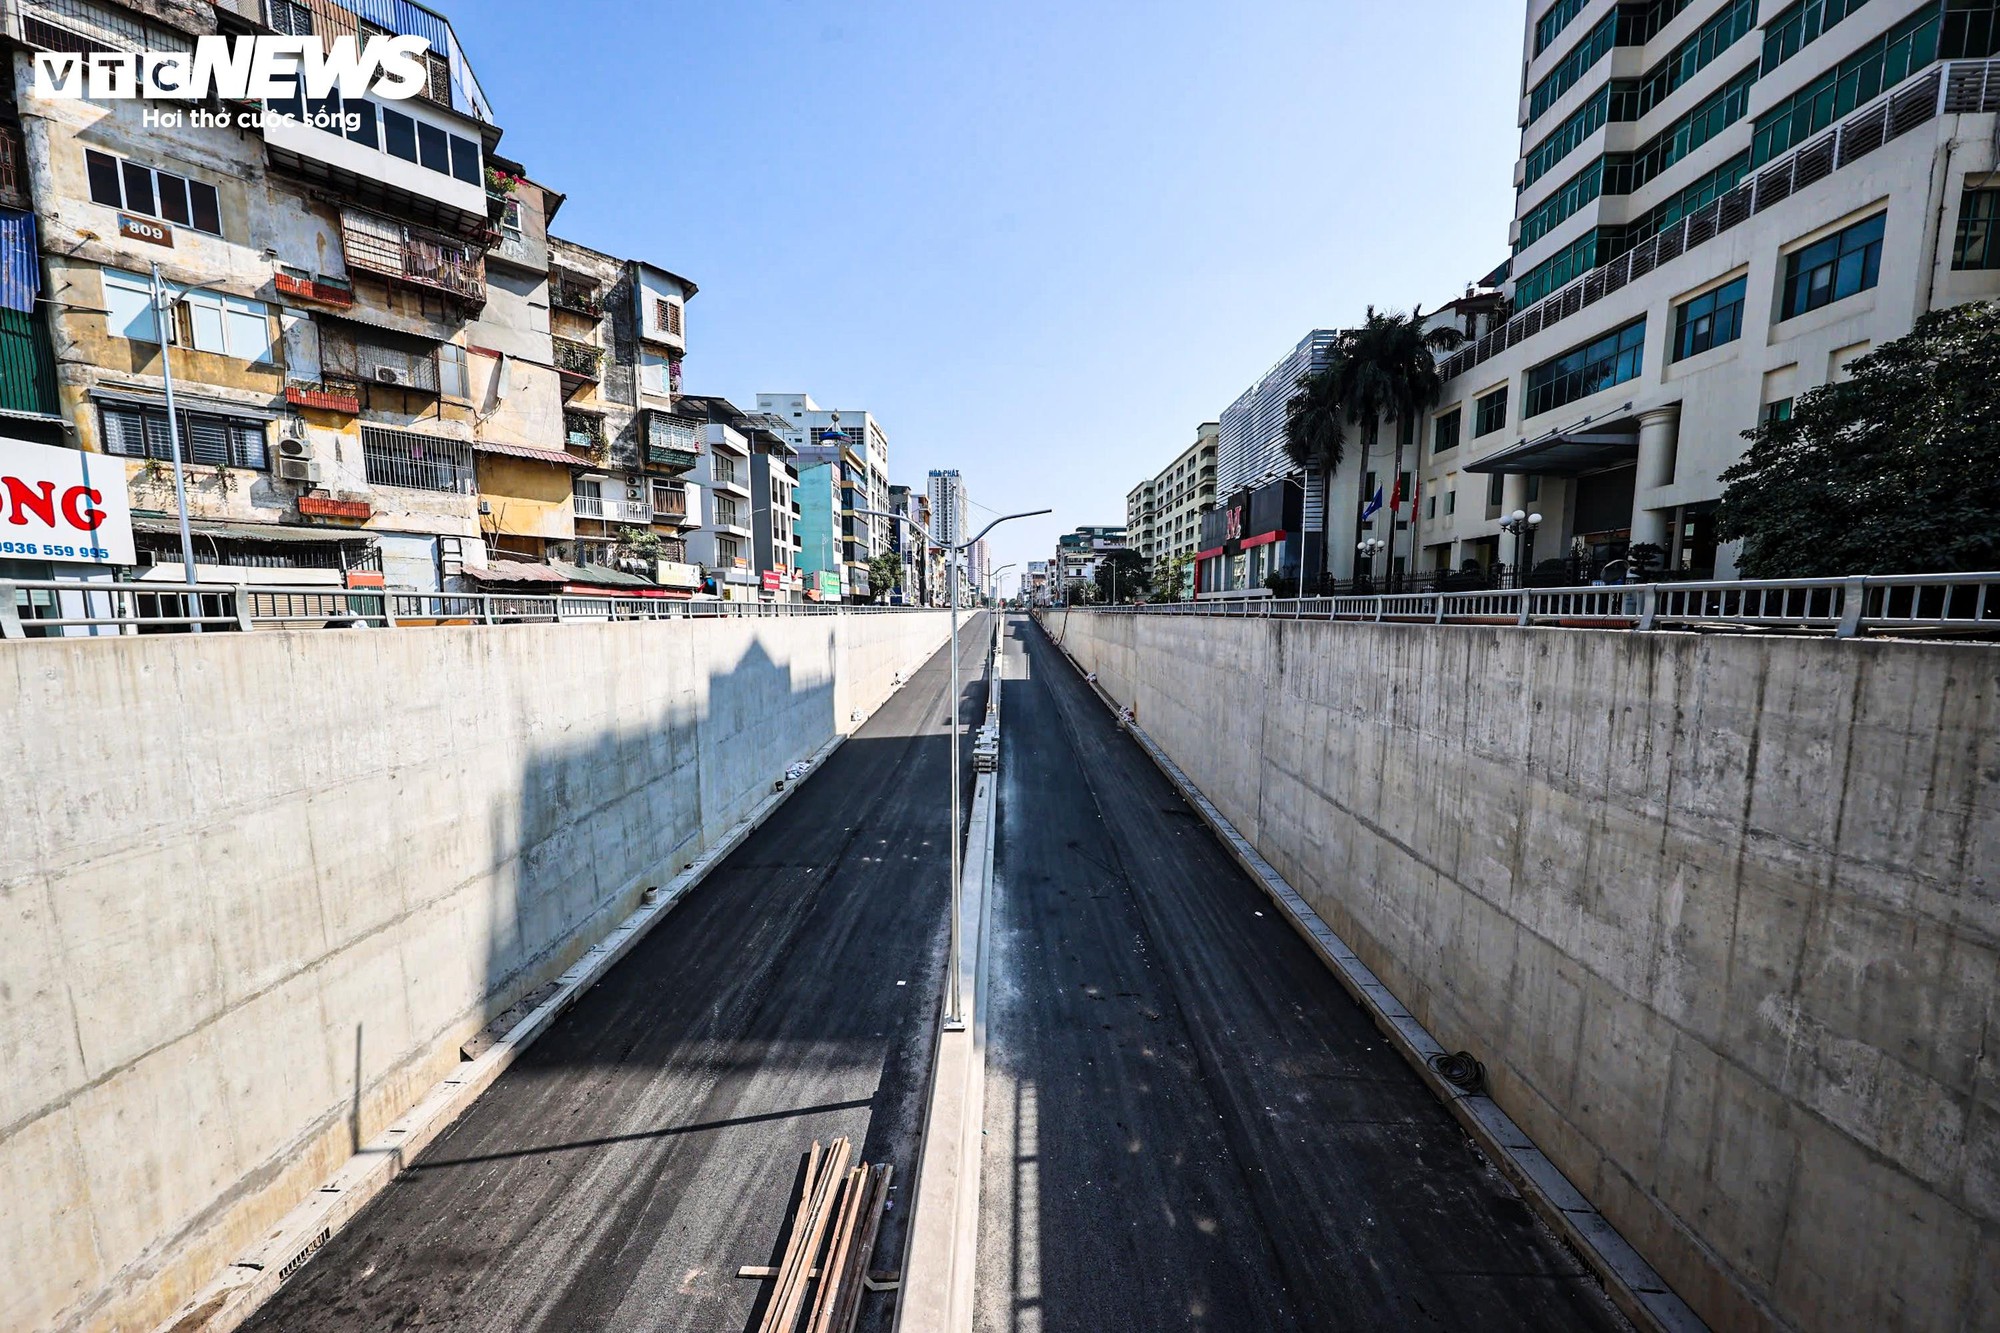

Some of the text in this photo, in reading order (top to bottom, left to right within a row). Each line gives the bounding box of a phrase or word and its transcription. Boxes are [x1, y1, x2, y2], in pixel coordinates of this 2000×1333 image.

[129, 221, 163, 240] 809
[0, 476, 107, 531] NG
[0, 541, 109, 559] 936 559 995
